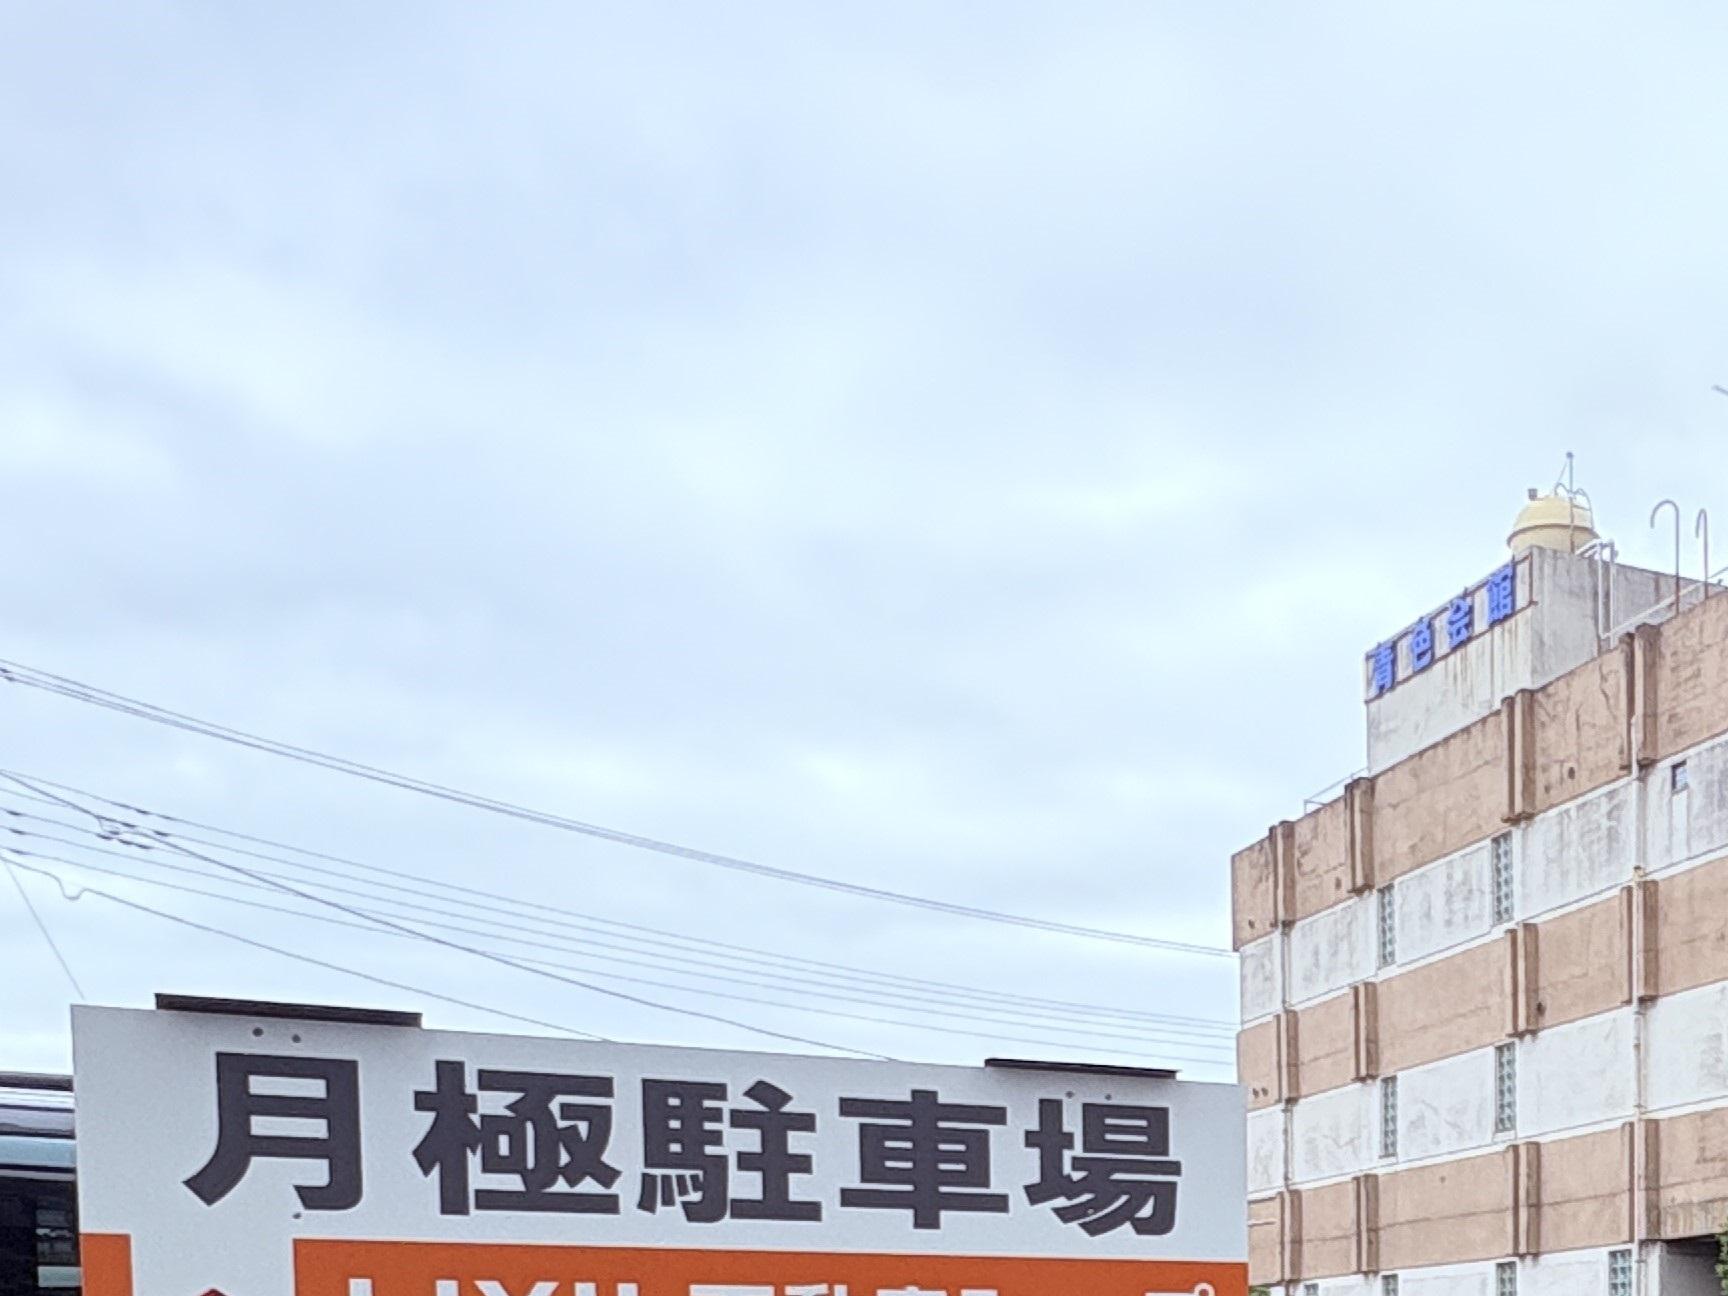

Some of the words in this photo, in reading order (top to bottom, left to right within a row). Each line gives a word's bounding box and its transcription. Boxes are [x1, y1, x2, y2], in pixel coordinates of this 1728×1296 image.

[182, 1050, 1182, 1238] 月極駐車場
